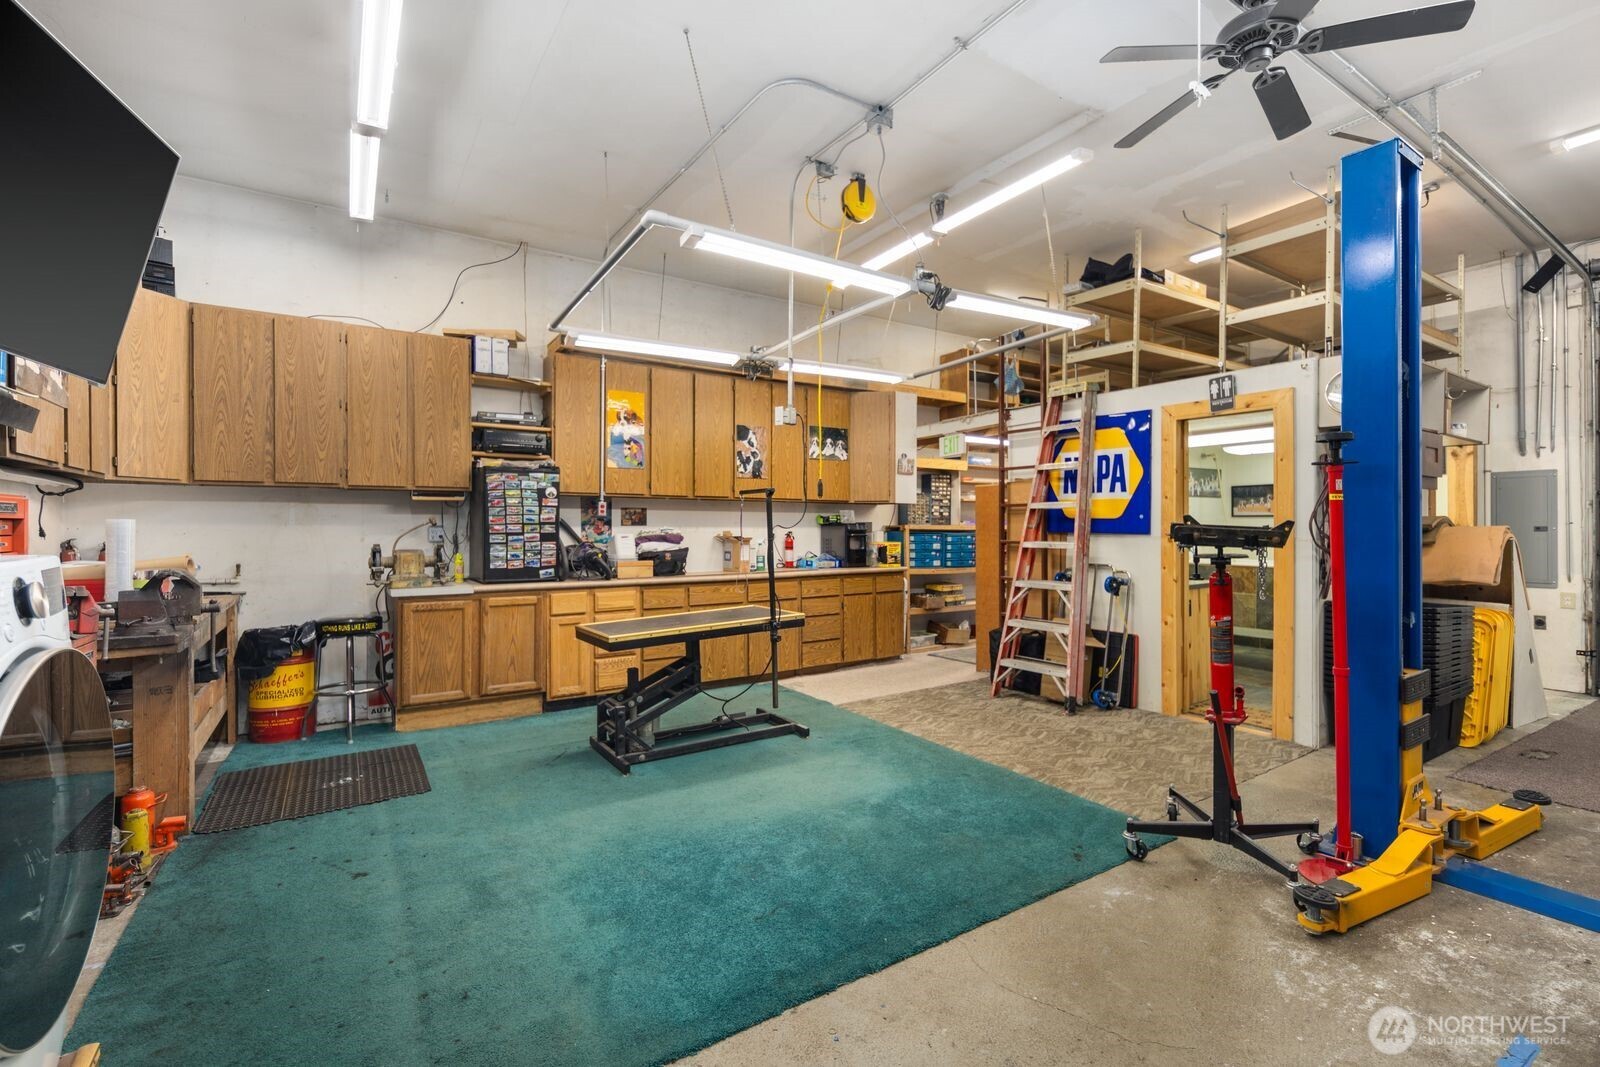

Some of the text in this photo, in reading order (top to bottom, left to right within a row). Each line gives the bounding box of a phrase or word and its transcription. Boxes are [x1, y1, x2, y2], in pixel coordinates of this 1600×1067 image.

[944, 434, 960, 455] EXIT
[1063, 453, 1127, 494] NPA
[351, 623, 361, 631] LIKE
[248, 669, 304, 693] Schaeffer's
[255, 691, 304, 701] LUBRICANTS
[256, 687, 304, 696] SPECIALIZED
